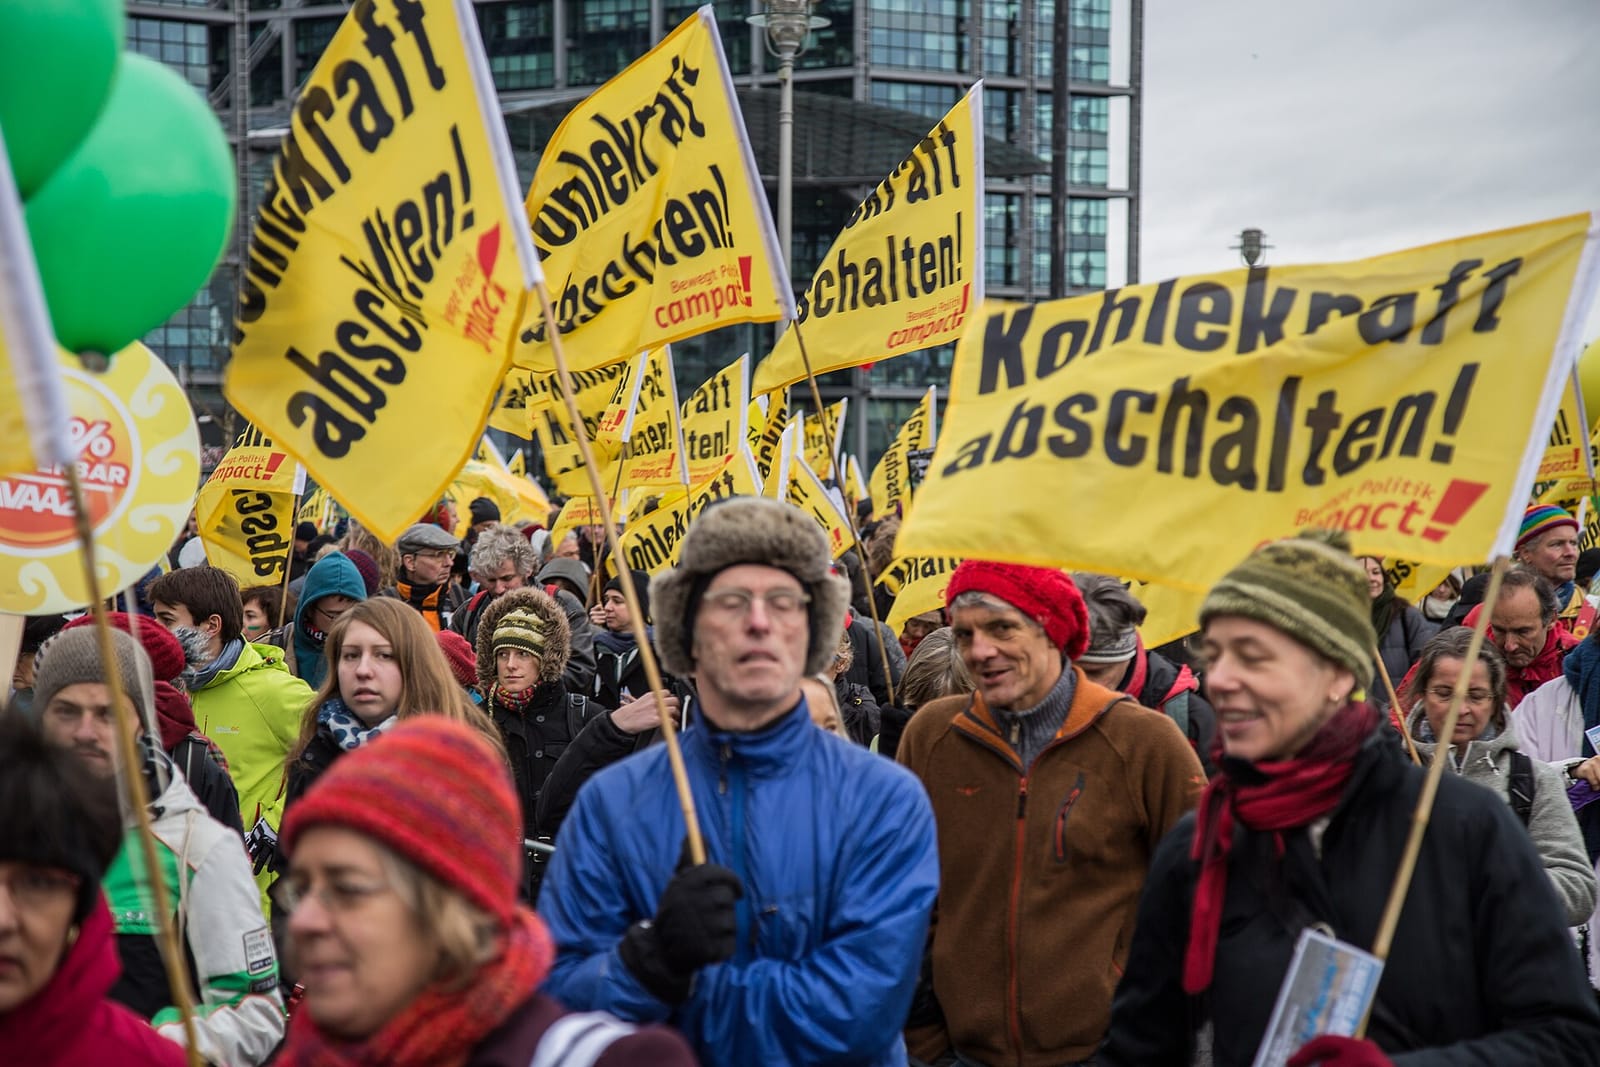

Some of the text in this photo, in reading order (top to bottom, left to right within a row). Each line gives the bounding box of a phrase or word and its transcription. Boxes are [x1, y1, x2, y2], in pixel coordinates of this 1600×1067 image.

[978, 256, 1523, 395] Kohlekraft
[208, 452, 287, 483] mpact!
[941, 362, 1480, 493] abschalten!
[1360, 476, 1437, 501] Politik
